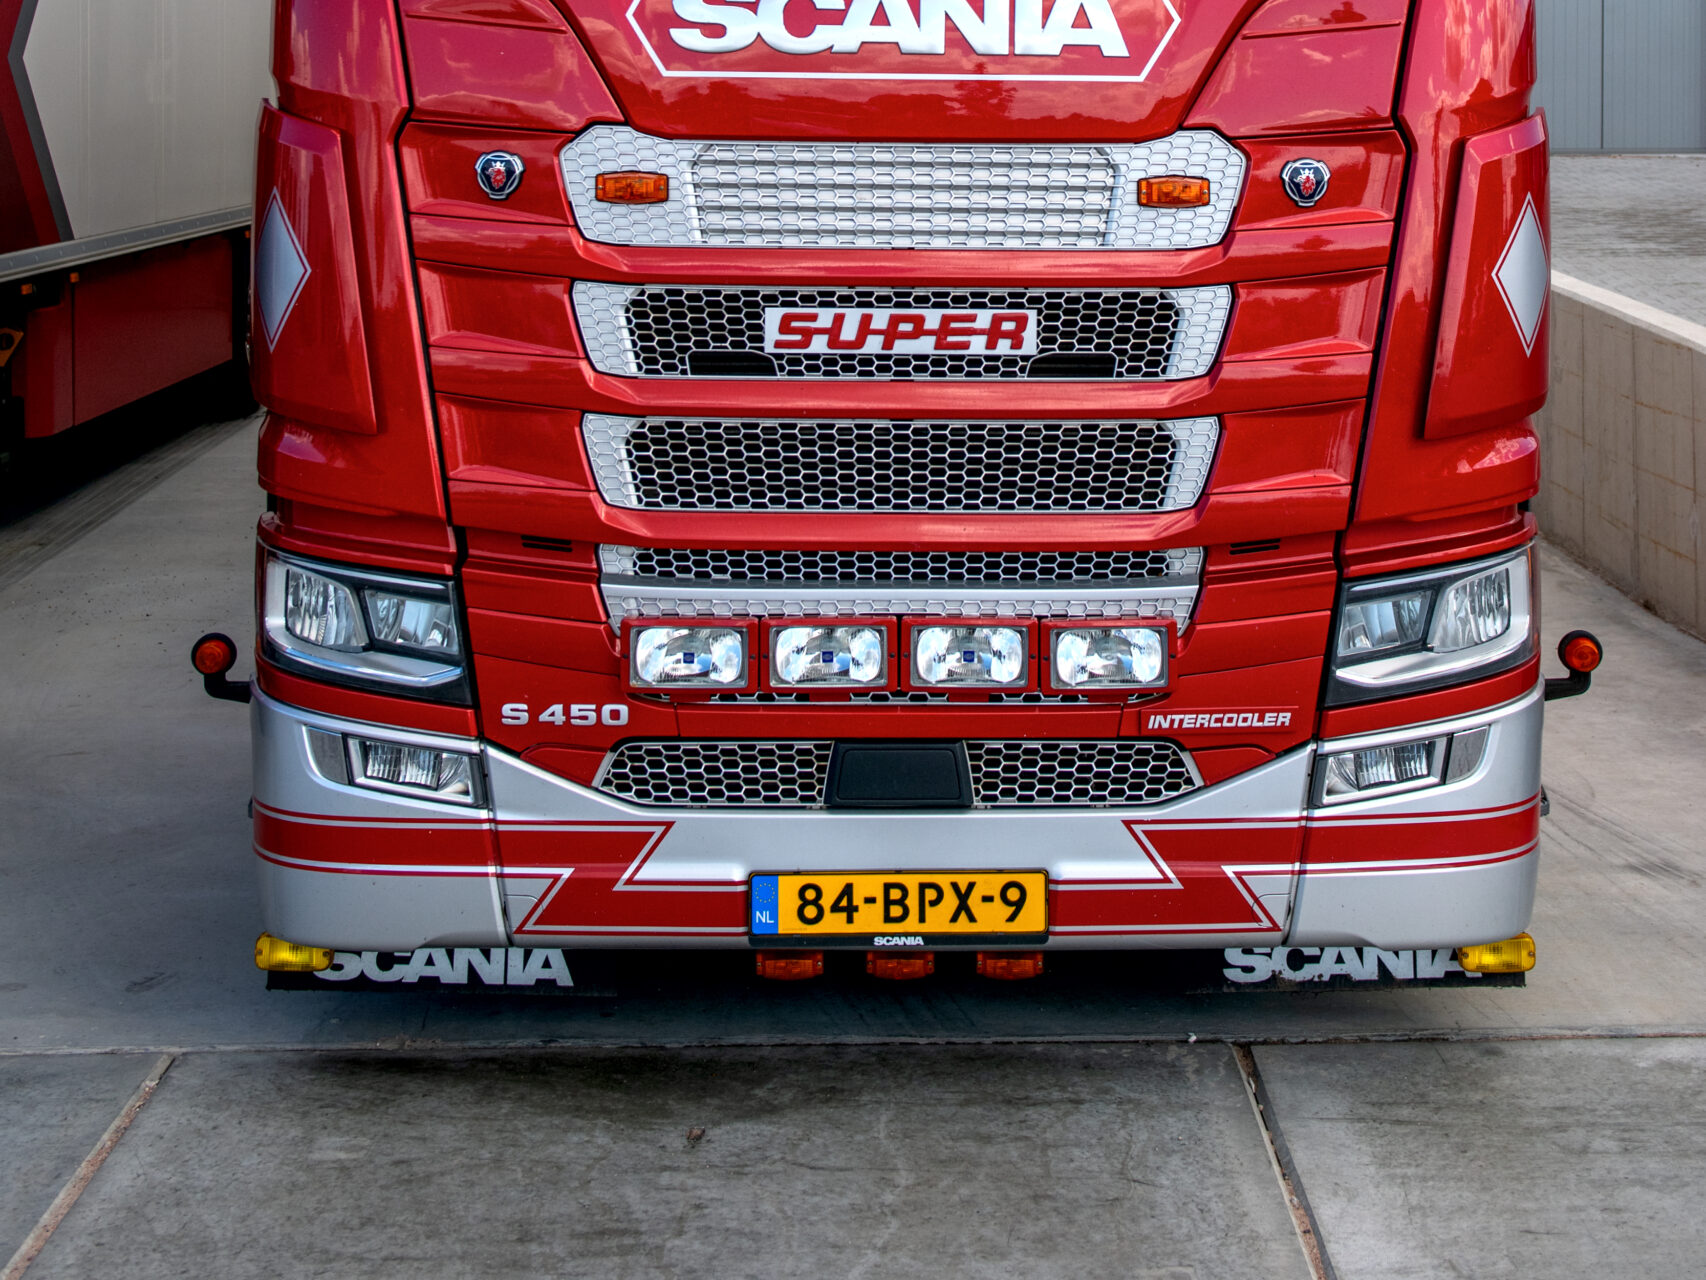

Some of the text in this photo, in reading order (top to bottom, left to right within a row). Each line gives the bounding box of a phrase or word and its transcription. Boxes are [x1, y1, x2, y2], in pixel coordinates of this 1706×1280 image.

[773, 312, 1030, 351] SUPER
[501, 703, 629, 726] S 450
[1147, 712, 1292, 730] INTERCOOLER
[796, 880, 1028, 926] 84-BPX-9
[755, 910, 775, 924] NL
[873, 936, 925, 947] SCANIA
